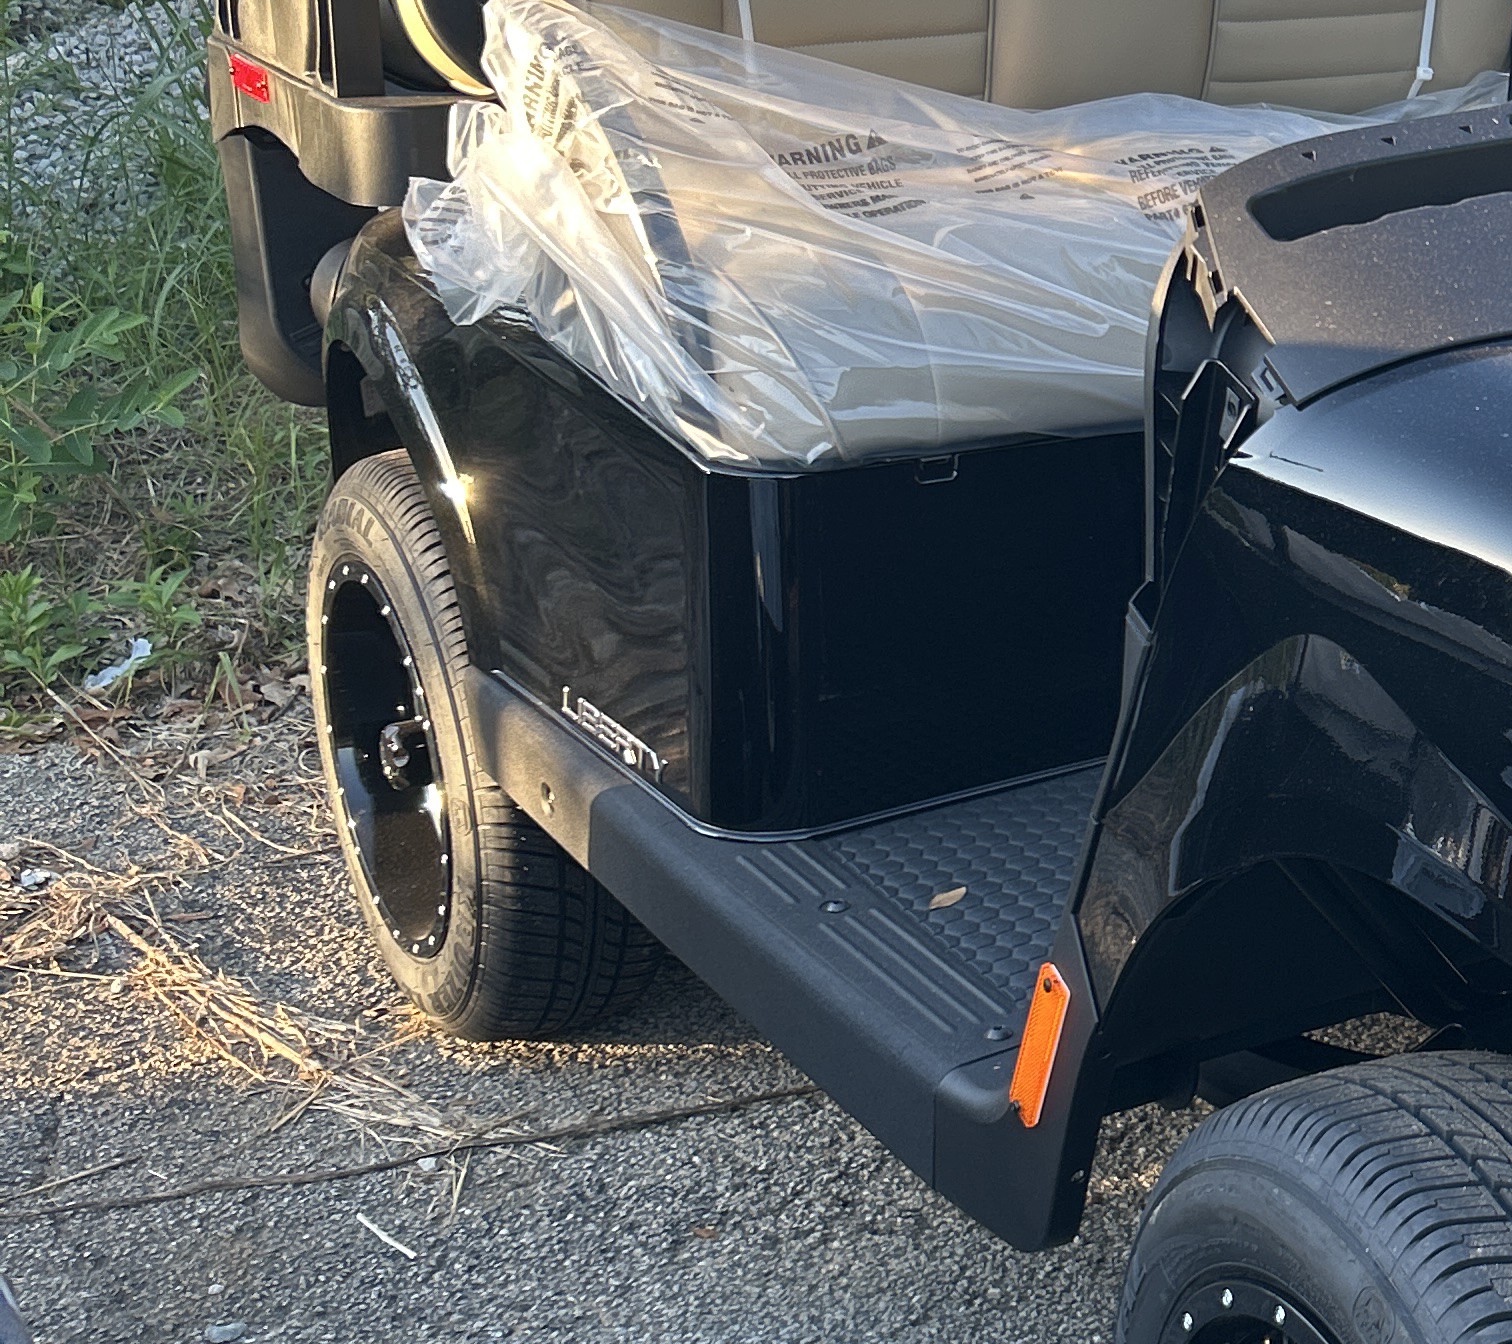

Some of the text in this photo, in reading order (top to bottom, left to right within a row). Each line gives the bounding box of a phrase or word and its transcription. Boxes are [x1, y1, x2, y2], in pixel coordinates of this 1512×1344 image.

[769, 133, 863, 167] ARNING
[803, 164, 867, 181] PROTECTIVE
[867, 155, 897, 176] BAGS
[1137, 182, 1181, 211] BEFORE
